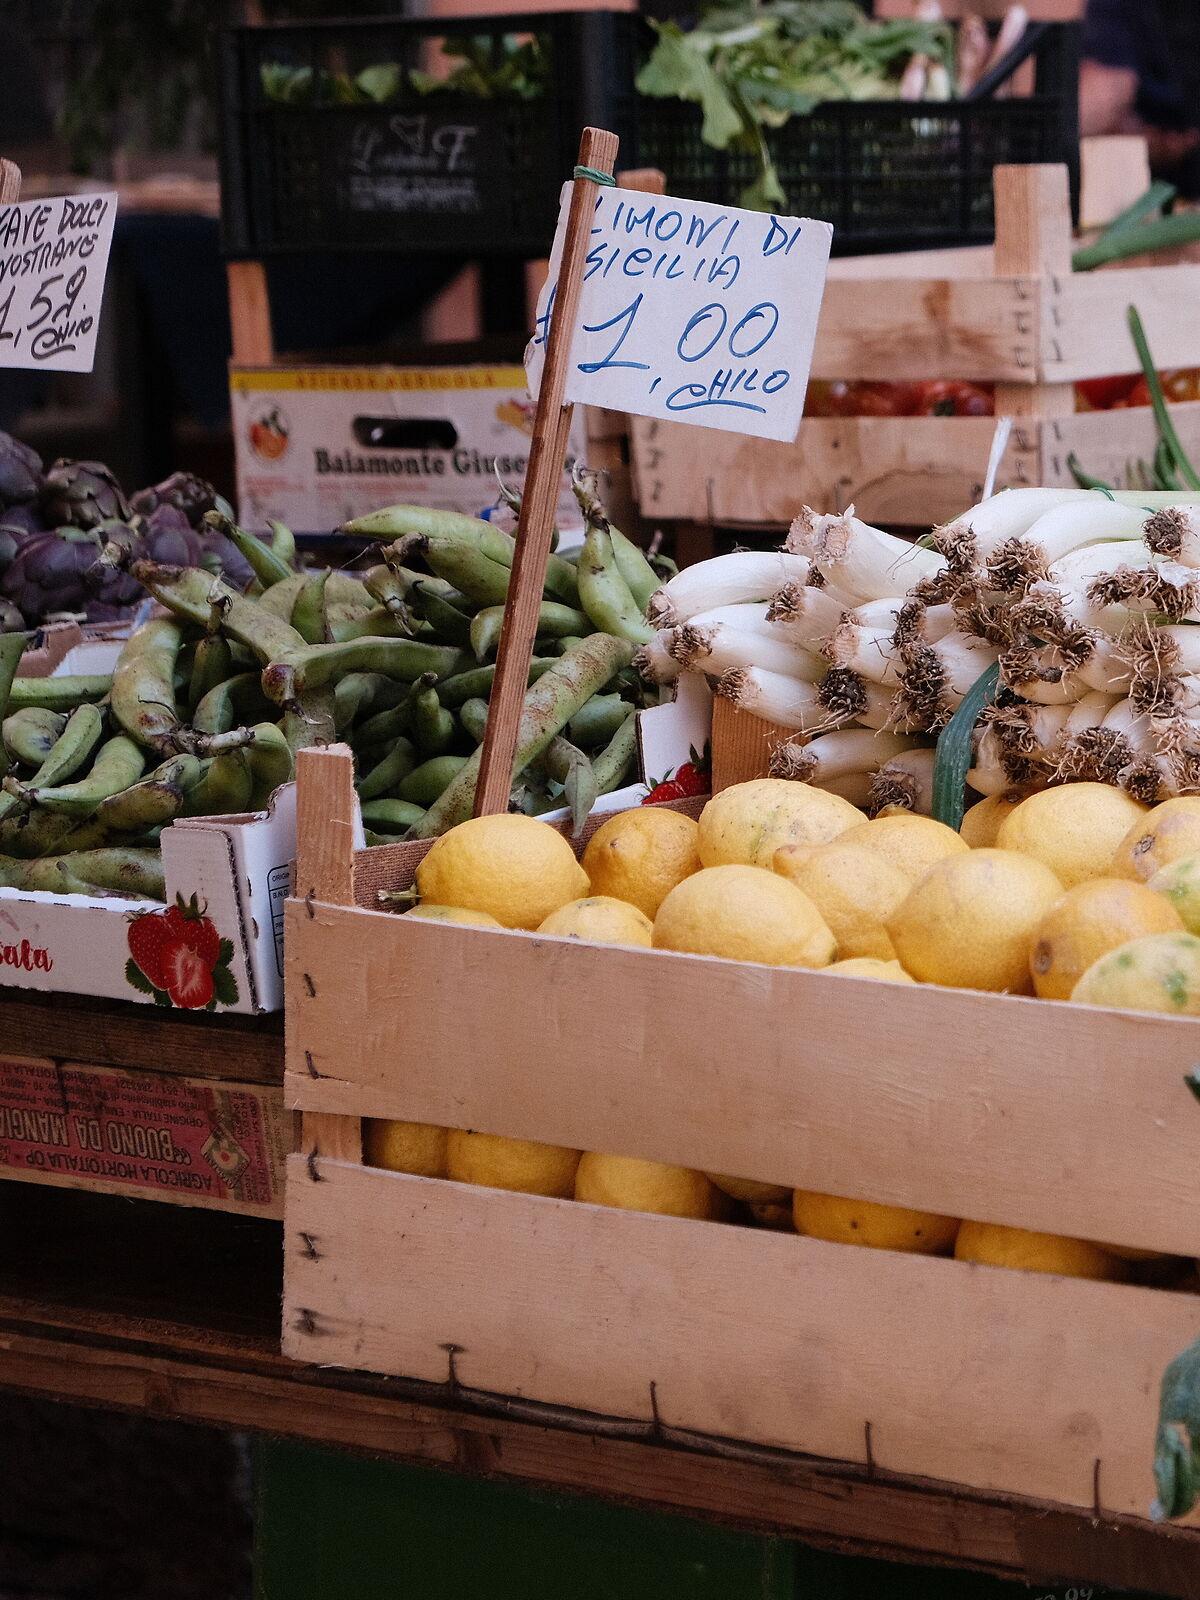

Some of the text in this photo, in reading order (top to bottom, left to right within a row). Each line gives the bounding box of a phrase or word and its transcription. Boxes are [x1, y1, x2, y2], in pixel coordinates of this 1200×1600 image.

[58, 198, 109, 236] DOLCI
[762, 216, 802, 257] DI
[584, 242, 741, 290] SICILIA
[314, 447, 576, 476] Baiamonte Giusee
[0, 939, 54, 974] ala
[74, 1115, 103, 1151] DA
[26, 1150, 45, 1166] OP
[48, 1153, 138, 1179] HORTOITALIA
[141, 1168, 212, 1191] AGRICOLA
